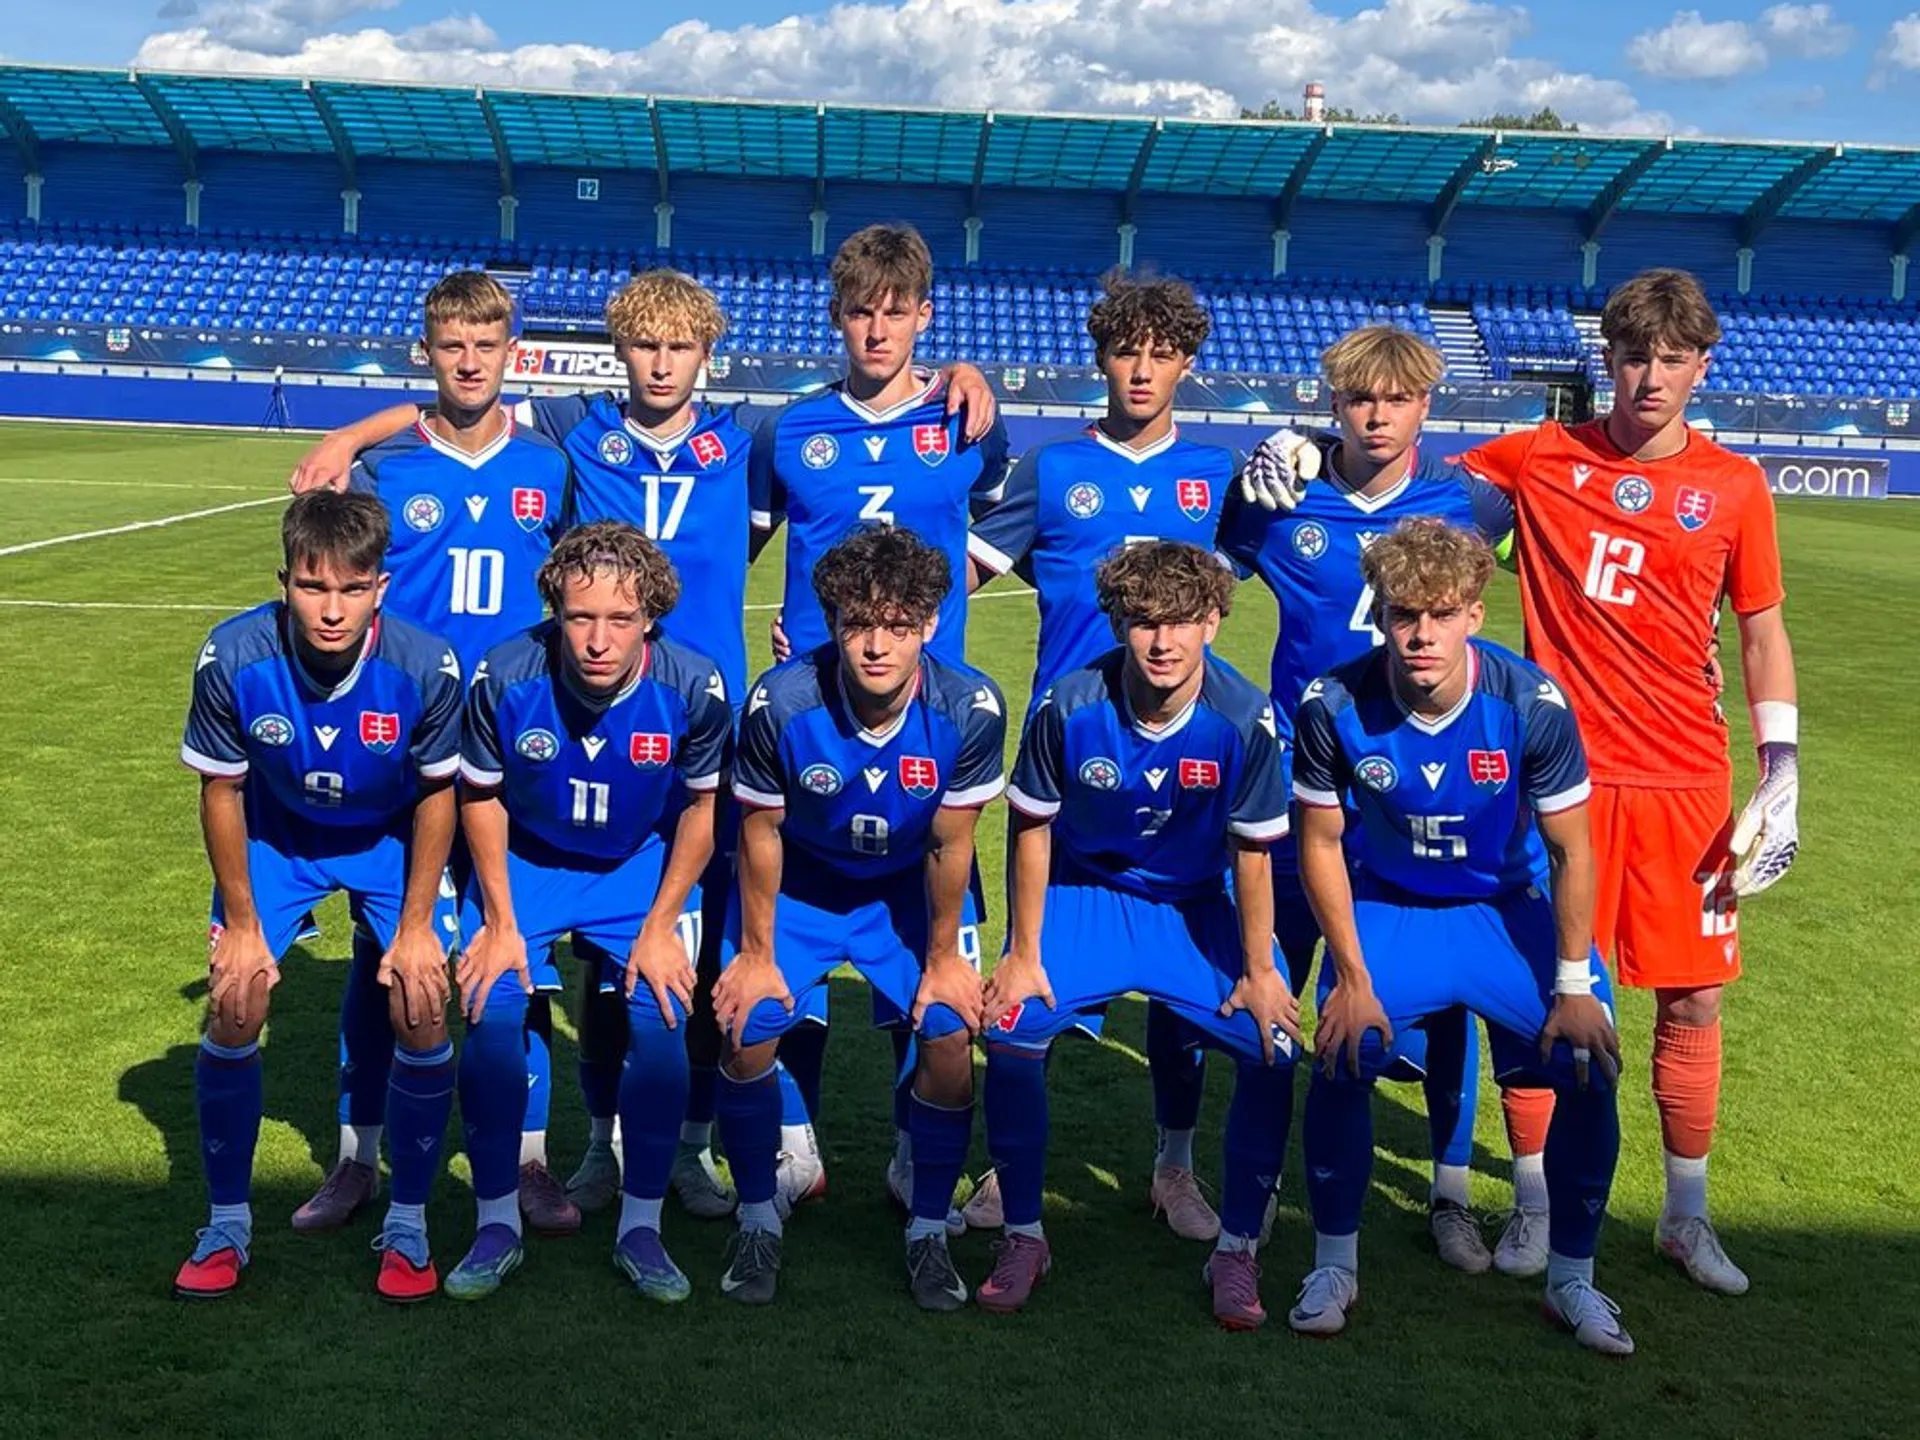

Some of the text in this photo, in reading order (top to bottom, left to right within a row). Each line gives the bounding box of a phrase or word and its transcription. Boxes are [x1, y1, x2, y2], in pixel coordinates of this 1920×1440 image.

[640, 474, 695, 540] 17
[448, 547, 505, 616] 10
[1584, 530, 1646, 607] 12
[304, 771, 344, 808] 9
[568, 777, 610, 828] 11
[851, 813, 889, 855] 8
[1404, 814, 1468, 861] 15
